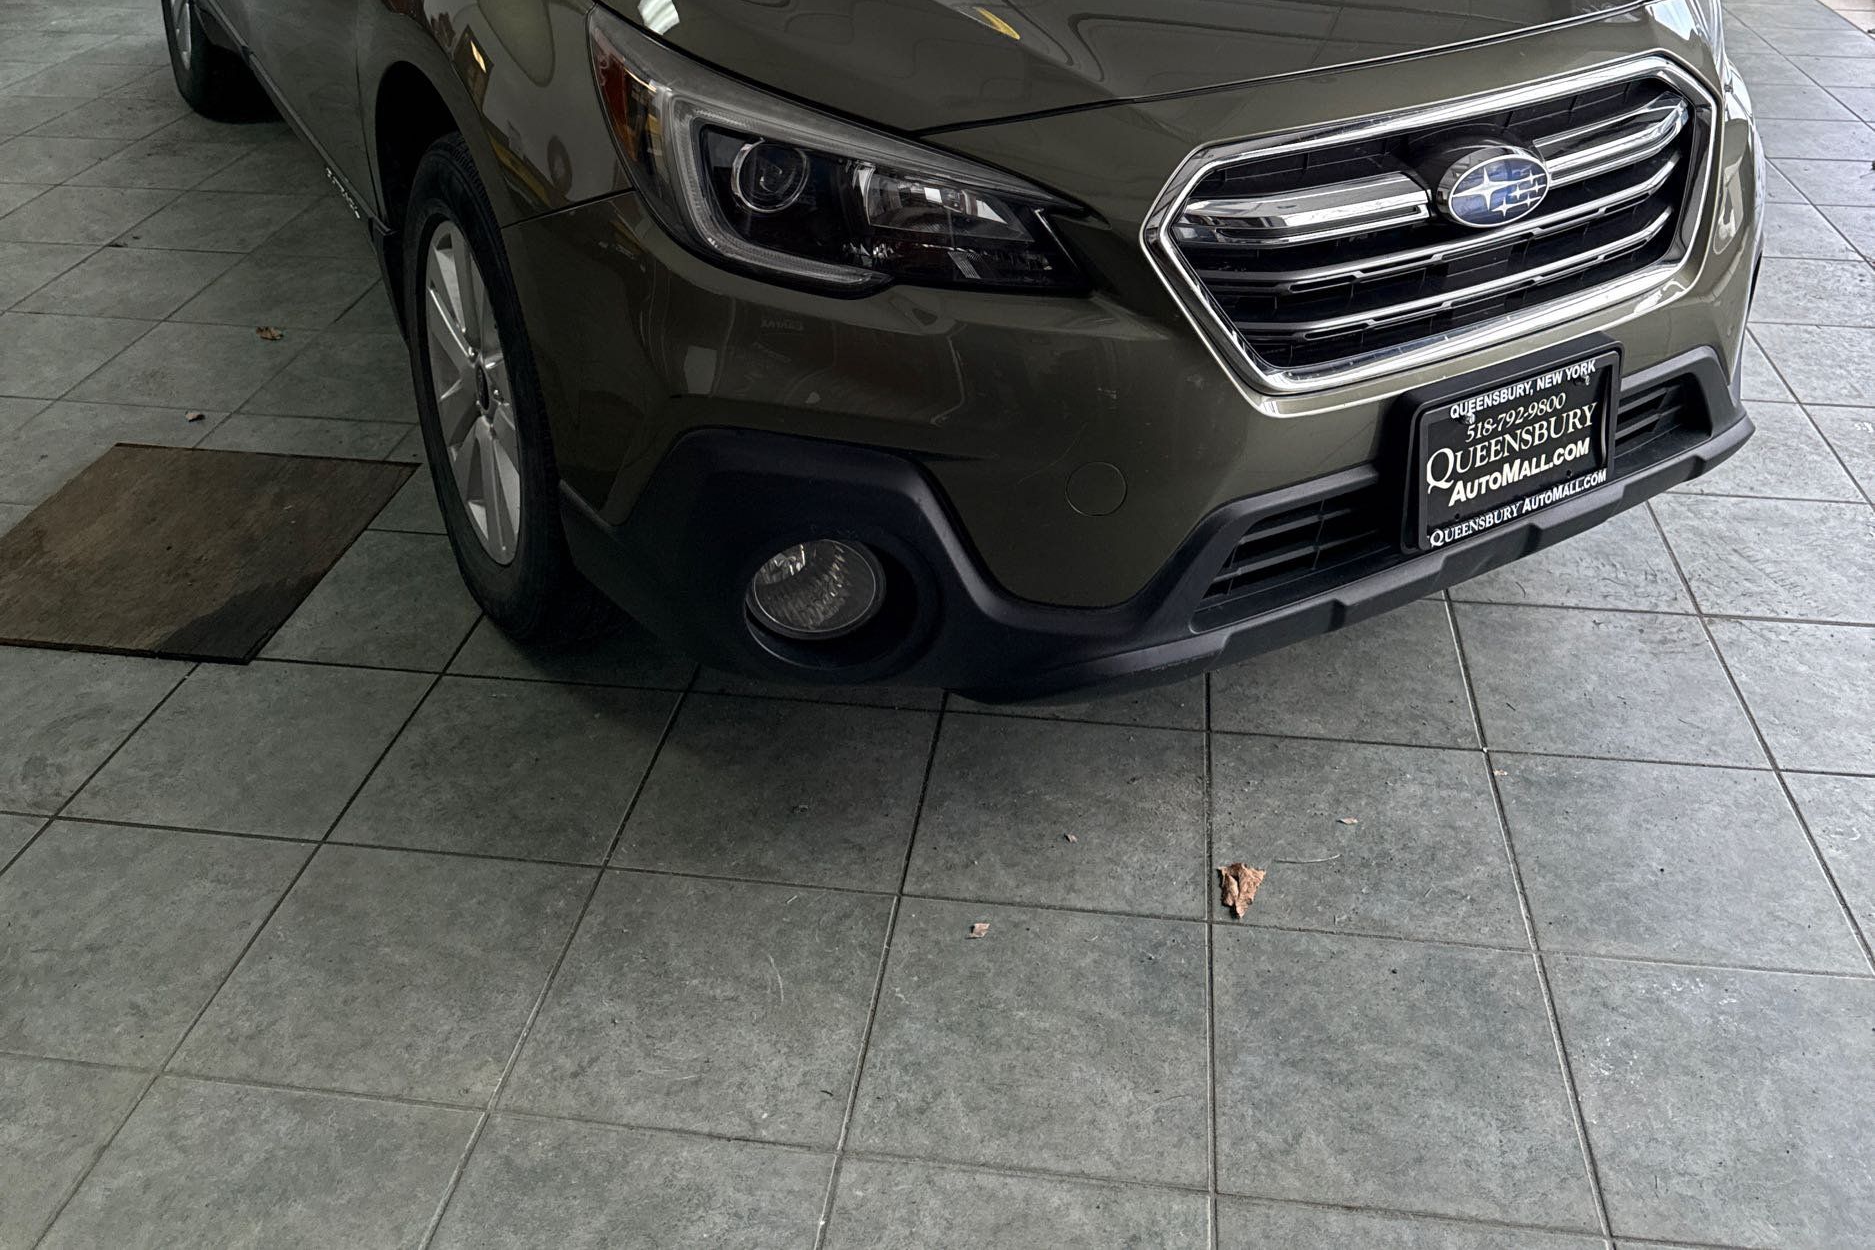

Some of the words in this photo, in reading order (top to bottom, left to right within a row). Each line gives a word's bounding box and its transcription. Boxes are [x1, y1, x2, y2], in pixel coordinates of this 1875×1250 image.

[1450, 381, 1534, 419] QUEENSBURY,
[1536, 371, 1564, 391] NEW
[1564, 359, 1597, 381] YORK
[1465, 392, 1567, 443] 518-792-9800
[1426, 402, 1598, 494] QUEENSBURY
[1430, 502, 1521, 548] QUEENSBURY
